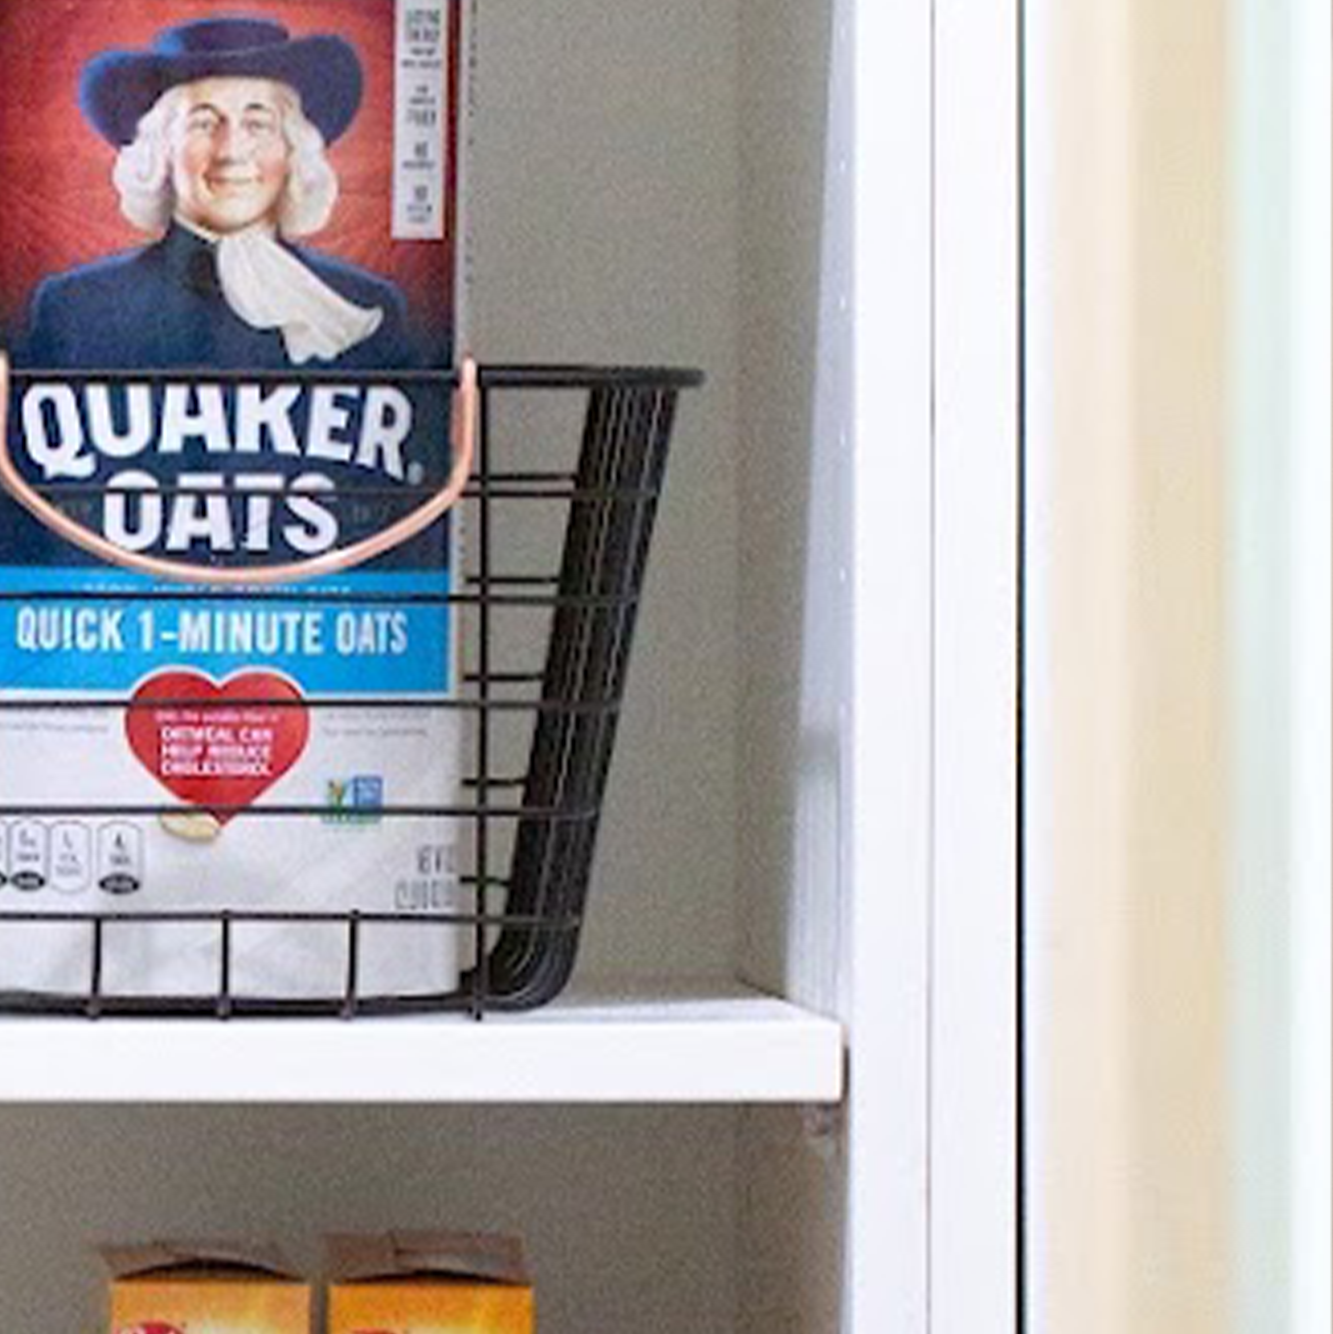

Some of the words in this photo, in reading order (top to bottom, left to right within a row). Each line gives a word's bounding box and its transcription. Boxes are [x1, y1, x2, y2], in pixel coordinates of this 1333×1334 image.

[22, 382, 415, 480] QUAKER
[104, 470, 340, 554] OATS
[16, 605, 124, 652] QUICK
[137, 607, 324, 655] 1-MINUTE
[335, 610, 410, 655] OATS
